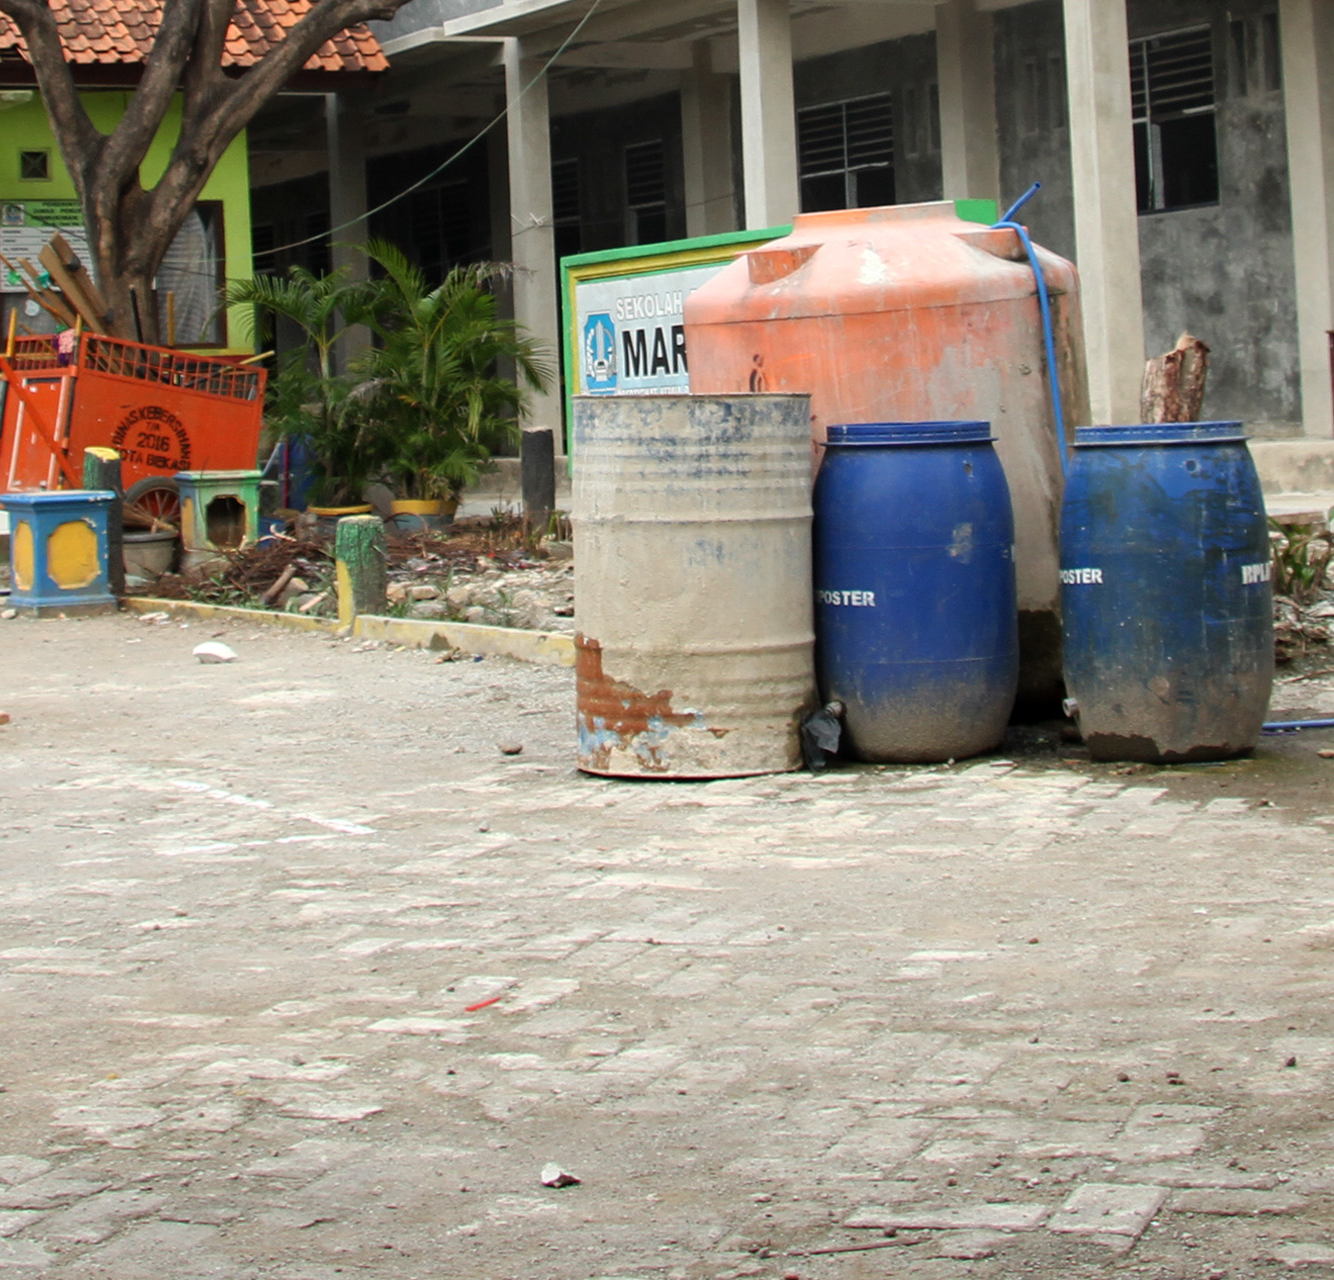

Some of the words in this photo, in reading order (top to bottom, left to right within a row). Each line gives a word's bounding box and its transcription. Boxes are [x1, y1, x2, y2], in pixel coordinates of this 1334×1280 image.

[617, 291, 683, 321] SEKOLAH
[111, 410, 138, 446] DINAS
[136, 432, 170, 452] 2016
[115, 448, 143, 464] OTA
[146, 453, 191, 472] BEKASI
